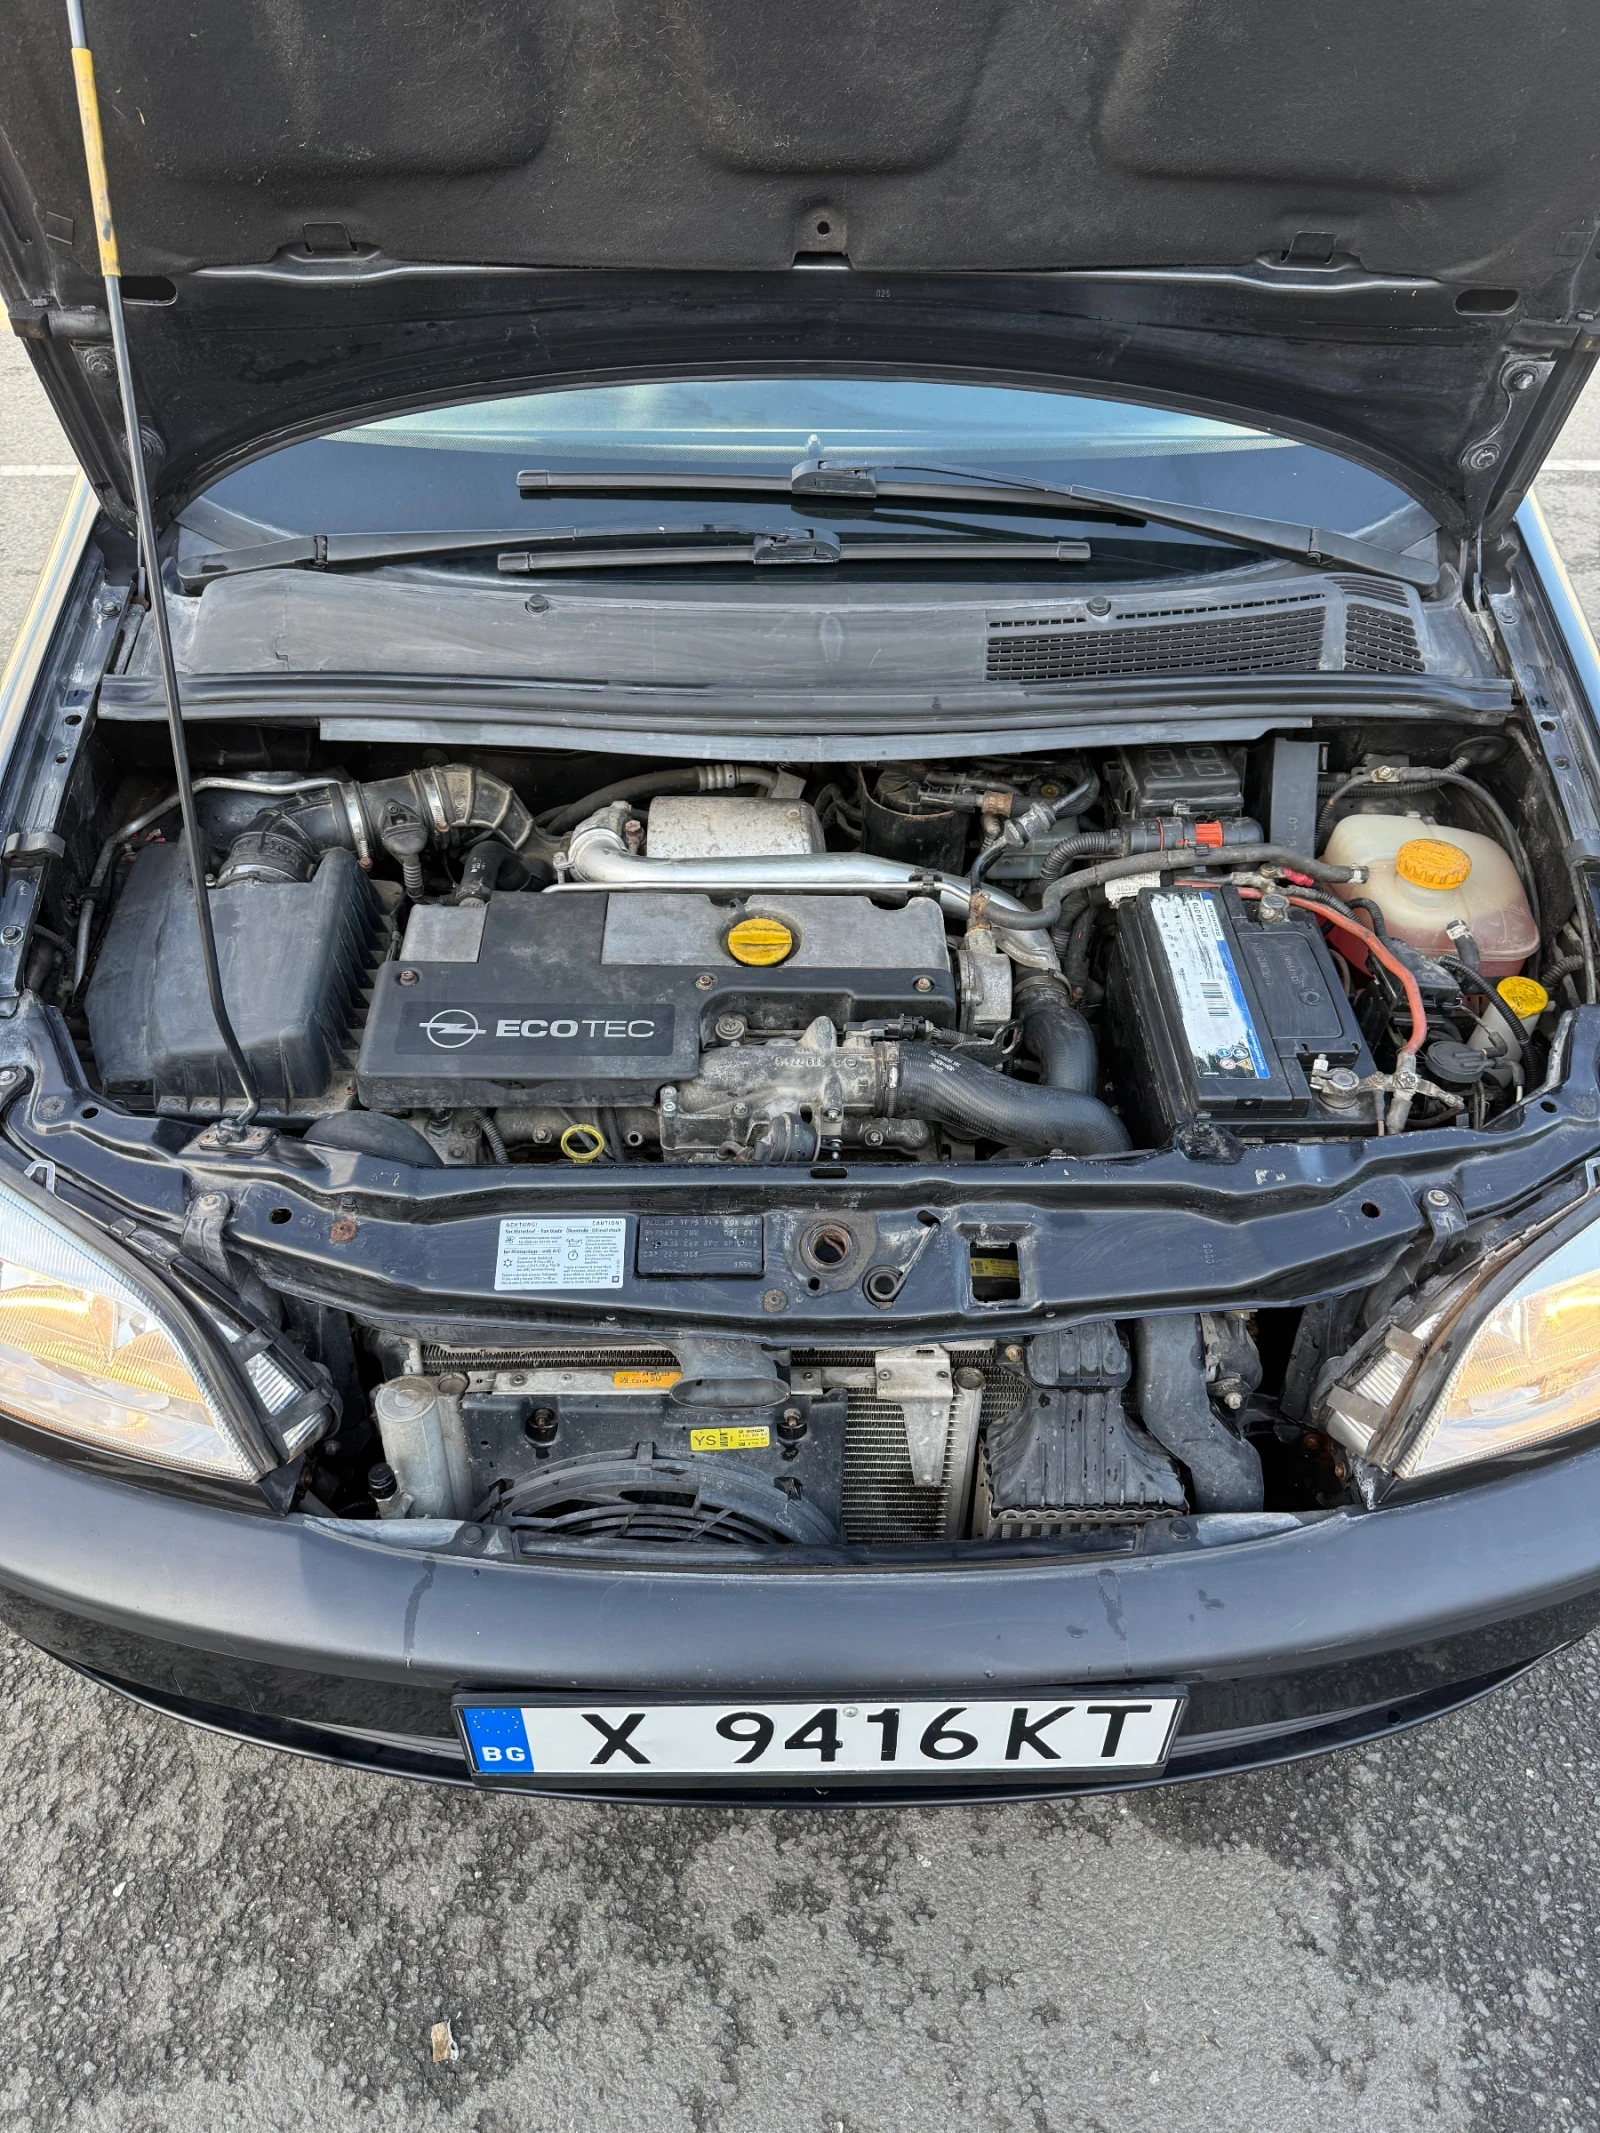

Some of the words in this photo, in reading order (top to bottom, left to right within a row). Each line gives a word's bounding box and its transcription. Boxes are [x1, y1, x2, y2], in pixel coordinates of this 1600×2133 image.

[875, 289, 891, 298] 025
[495, 1018, 655, 1039] ECOTEC
[694, 1435, 717, 1446] YS
[580, 1712, 648, 1764] X
[715, 1706, 980, 1764] 9416
[1004, 1704, 1153, 1760] KT
[481, 1746, 527, 1763] BG
